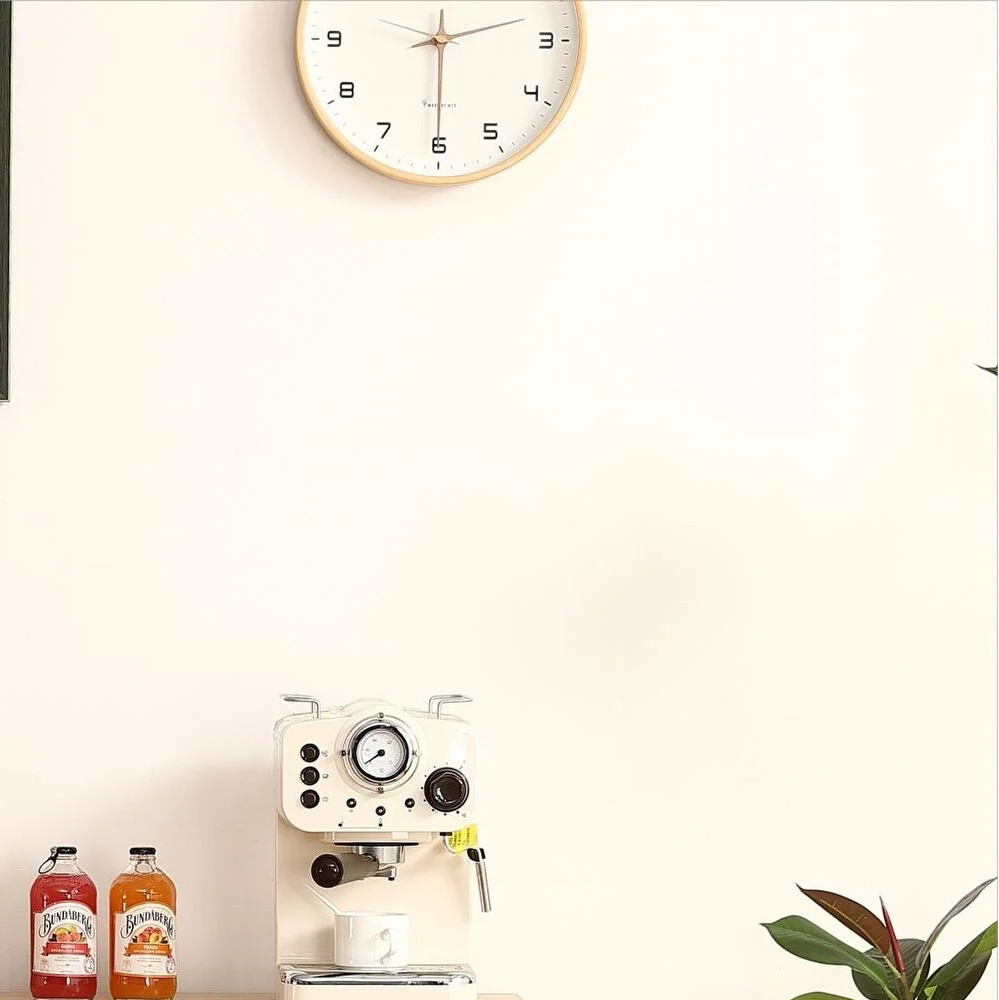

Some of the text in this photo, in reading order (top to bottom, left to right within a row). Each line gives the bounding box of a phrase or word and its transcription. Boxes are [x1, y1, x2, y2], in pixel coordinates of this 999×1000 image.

[327, 30, 342, 47] 9
[538, 31, 554, 49] 3
[339, 81, 355, 98] 8
[523, 84, 539, 102] 4
[376, 121, 391, 139] 7
[483, 122, 498, 140] 5
[431, 136, 447, 154] 6
[39, 909, 95, 939] BUNDABERG
[120, 909, 175, 940] BUNDABERG
